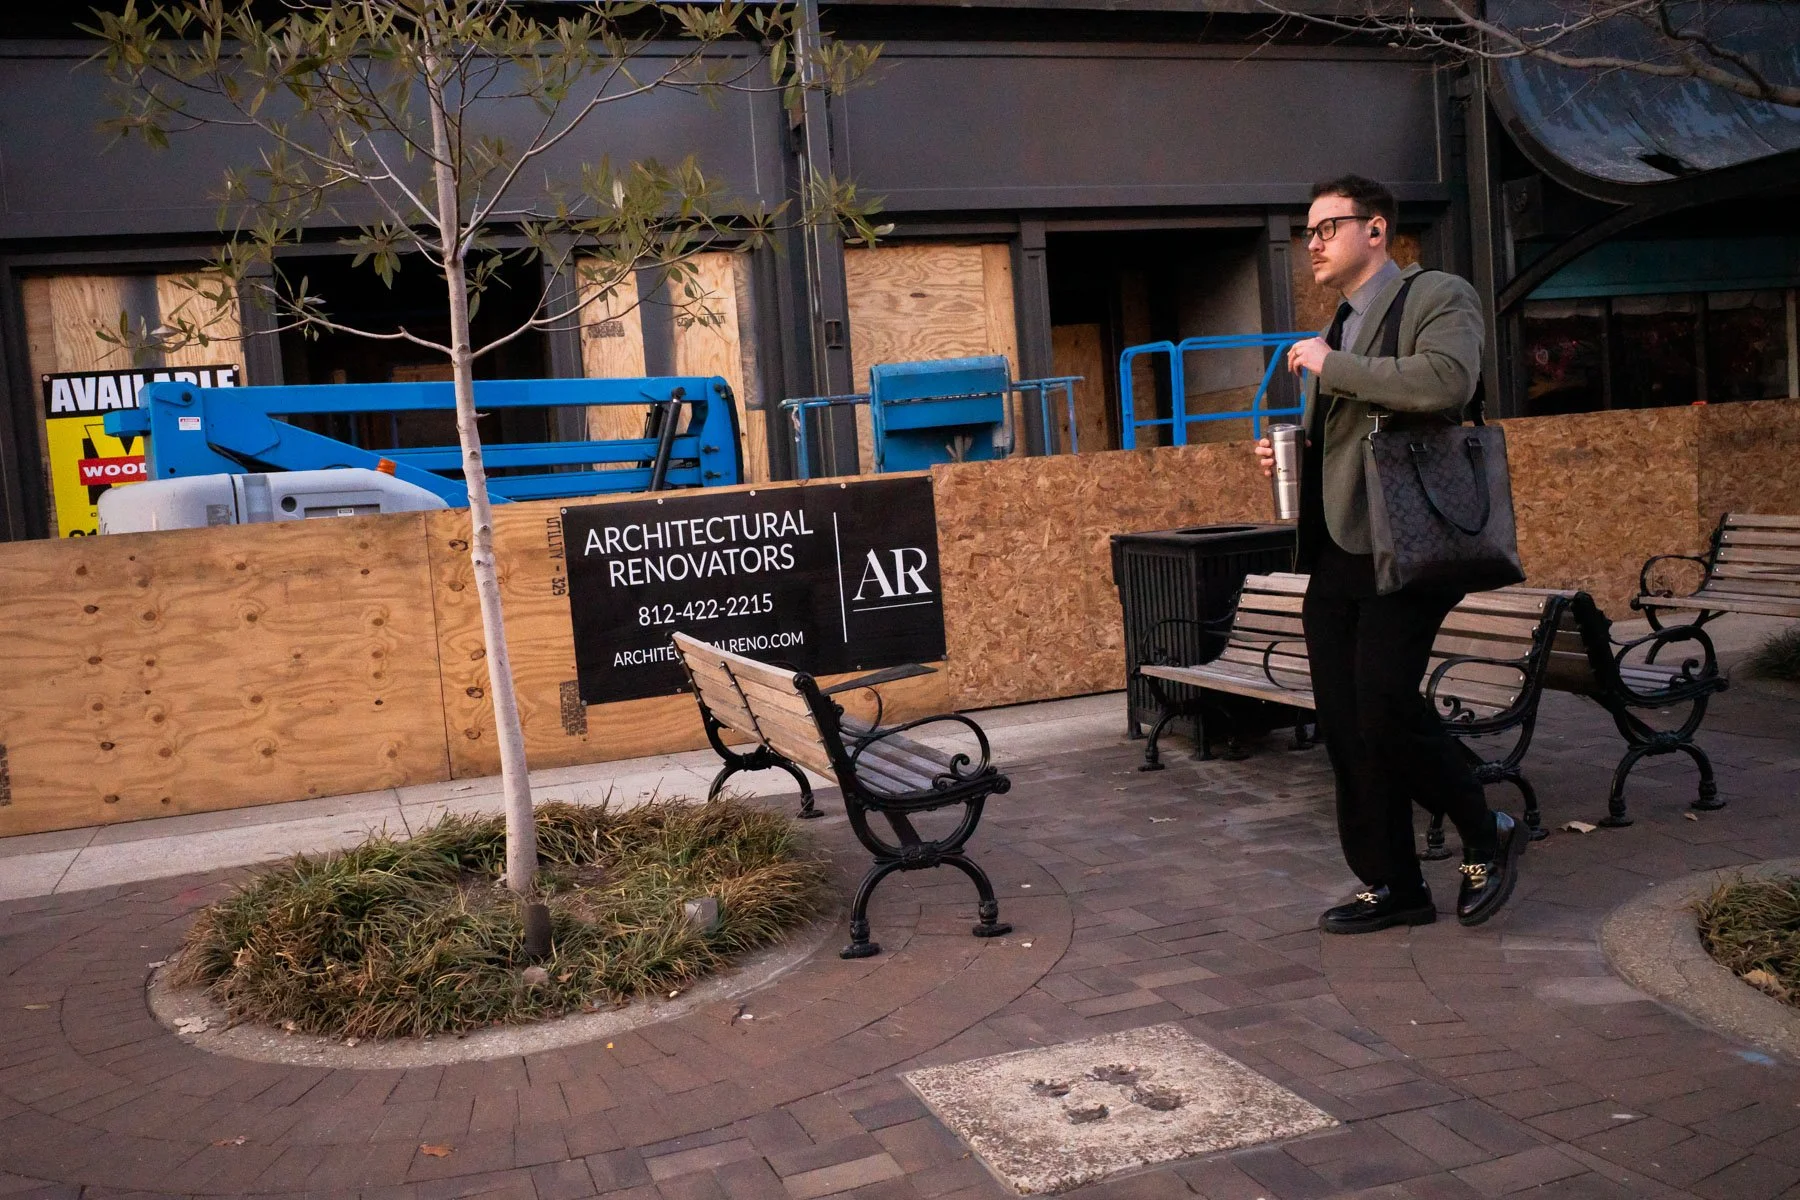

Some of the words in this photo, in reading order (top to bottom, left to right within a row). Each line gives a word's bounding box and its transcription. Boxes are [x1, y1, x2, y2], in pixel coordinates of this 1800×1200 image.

[546, 516, 564, 559] UTILITY
[584, 510, 814, 556] ARCHITECTURAL
[551, 576, 566, 596] 329
[609, 544, 795, 588] RENOVATORS
[852, 547, 933, 601] AR
[638, 593, 773, 627] 812-422-2215
[613, 631, 804, 667] ARCHITEALRENO.COM
